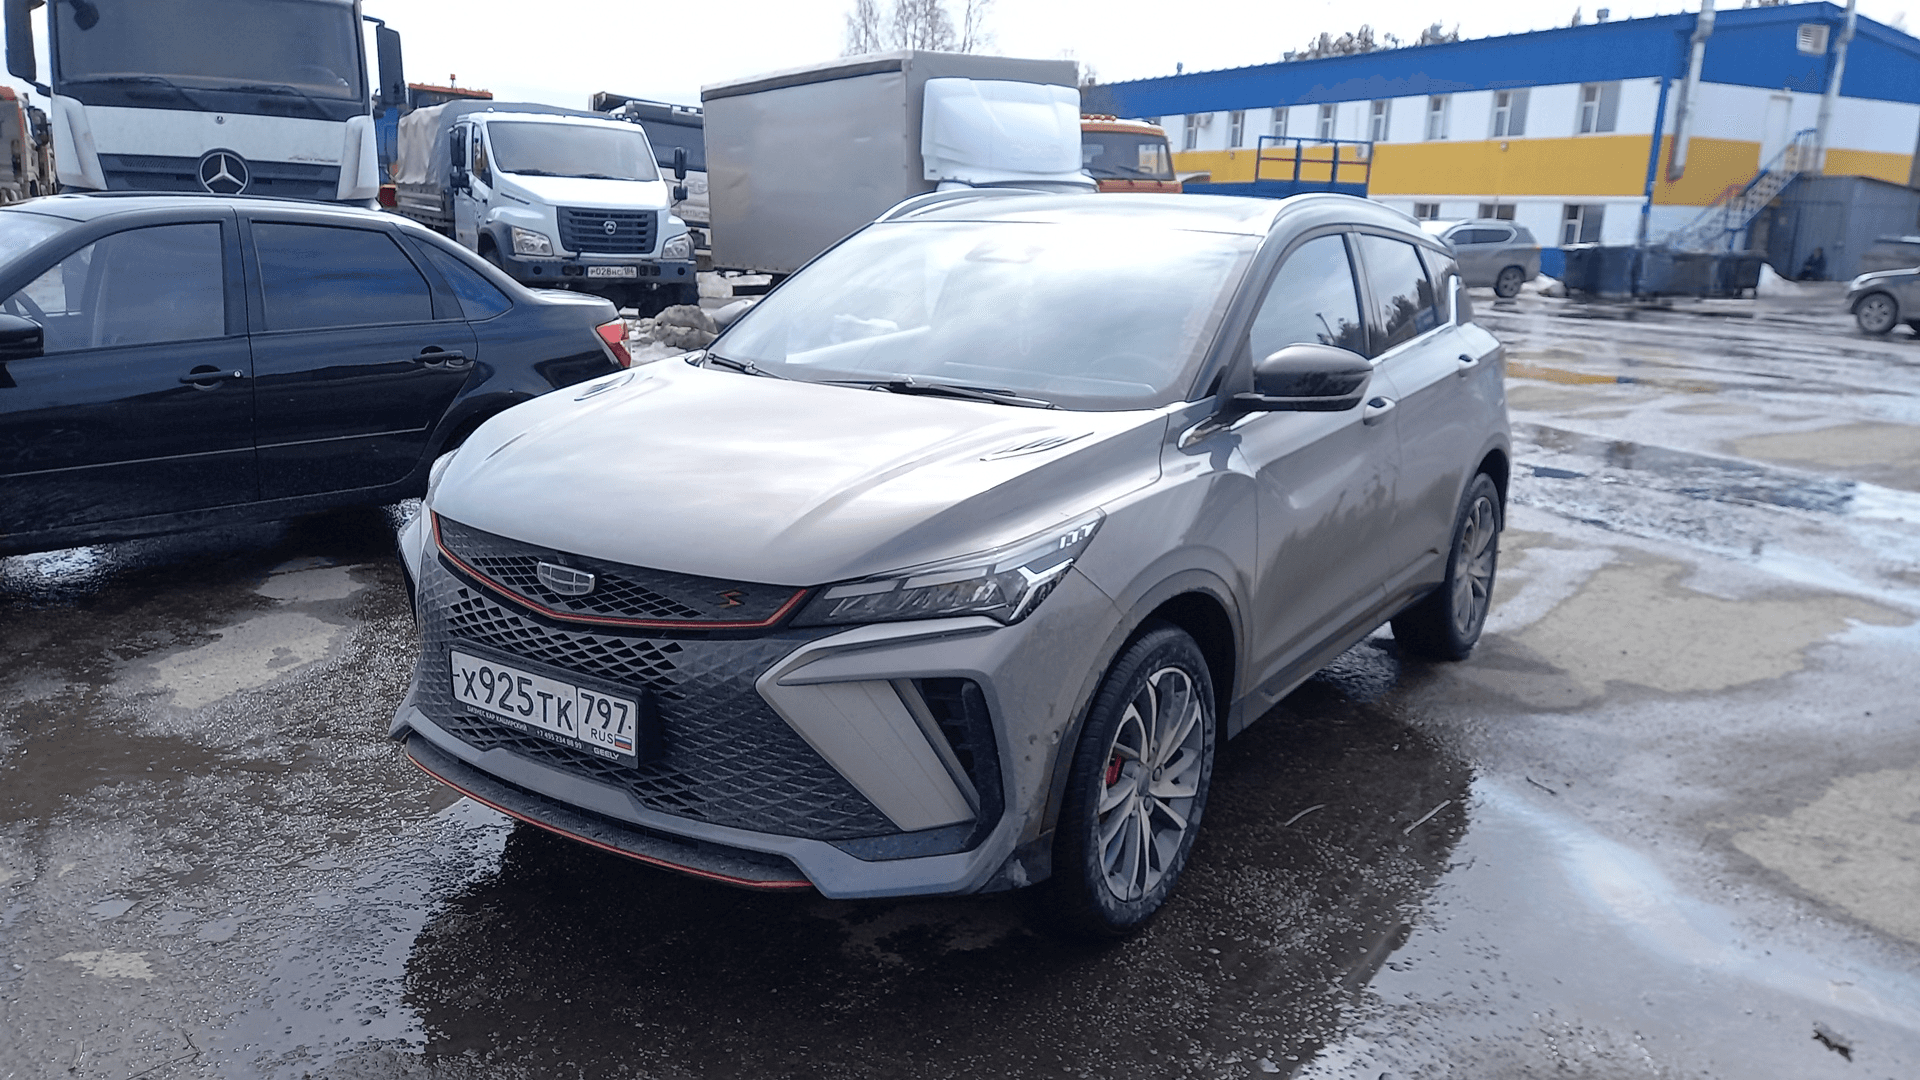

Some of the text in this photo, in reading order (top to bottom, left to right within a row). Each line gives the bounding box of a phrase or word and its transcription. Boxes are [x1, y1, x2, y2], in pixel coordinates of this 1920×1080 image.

[461, 666, 629, 734] Х925ТК 797
[590, 728, 614, 744] RUS
[593, 746, 620, 760] GEELY
